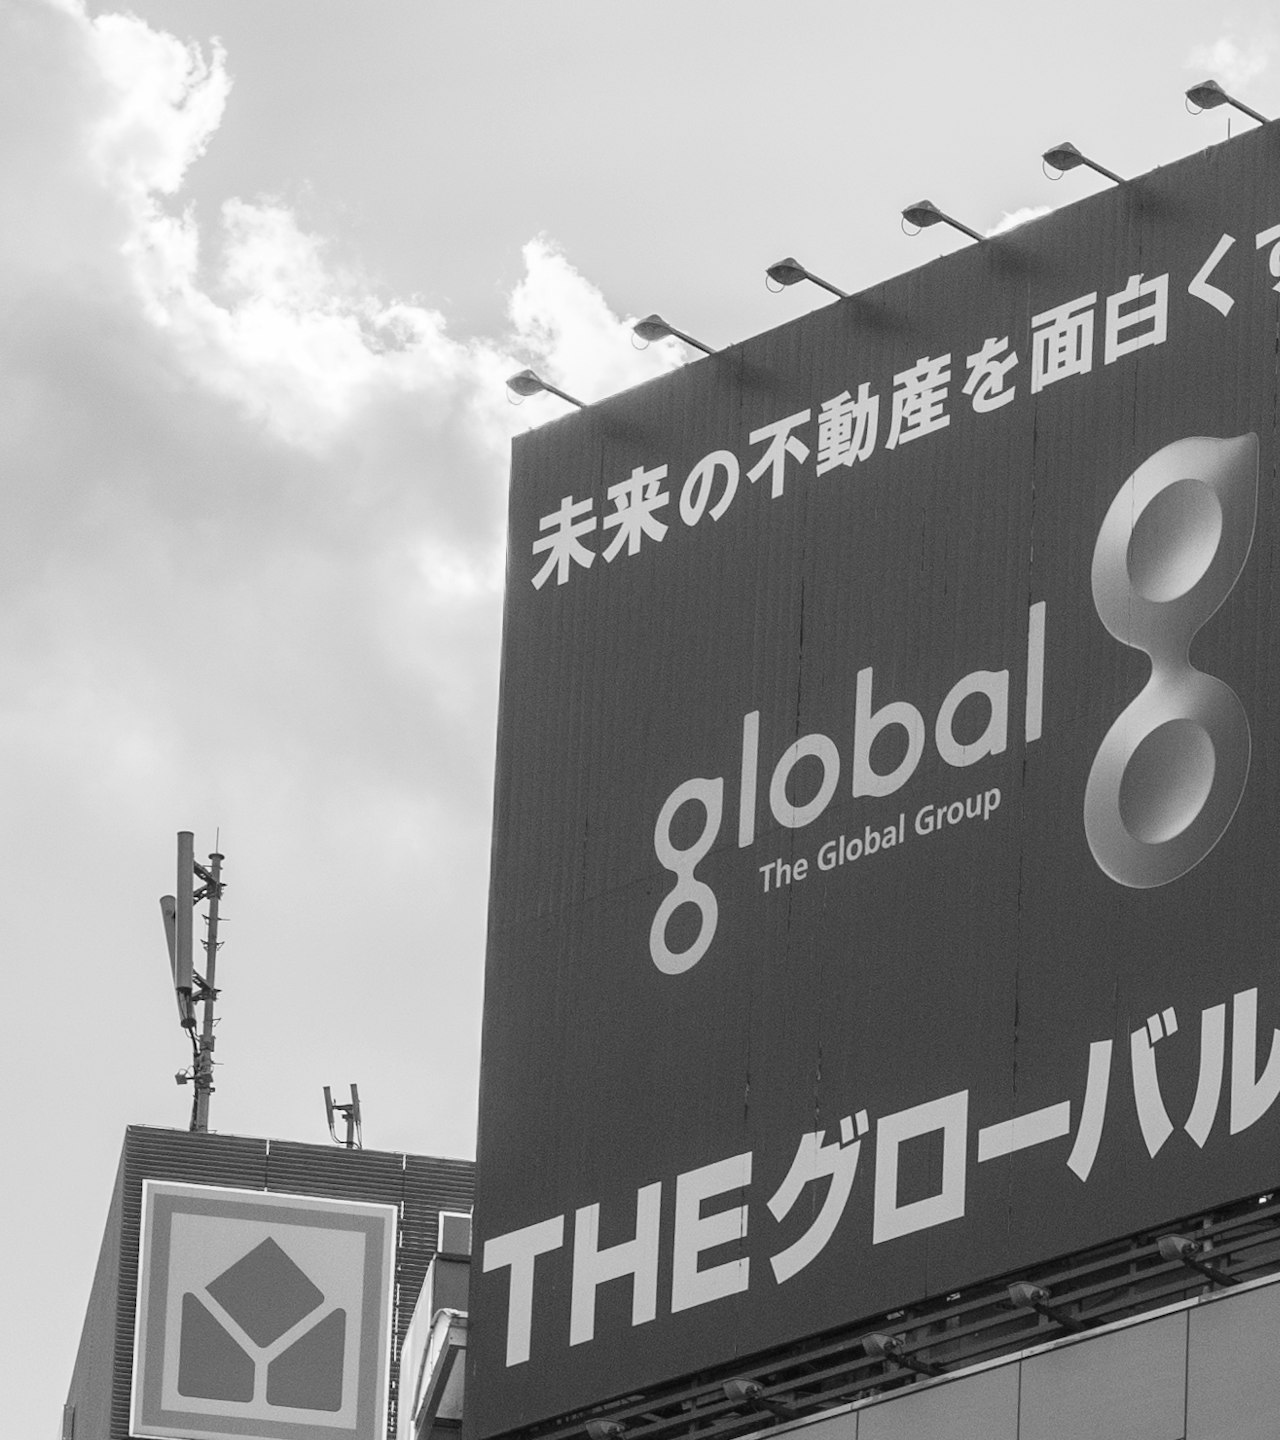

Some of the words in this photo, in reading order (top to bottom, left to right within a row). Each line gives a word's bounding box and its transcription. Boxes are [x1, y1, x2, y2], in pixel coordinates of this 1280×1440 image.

[648, 600, 1047, 975] global
[759, 858, 808, 894] The
[816, 813, 905, 871] Global
[914, 787, 1001, 837] Group
